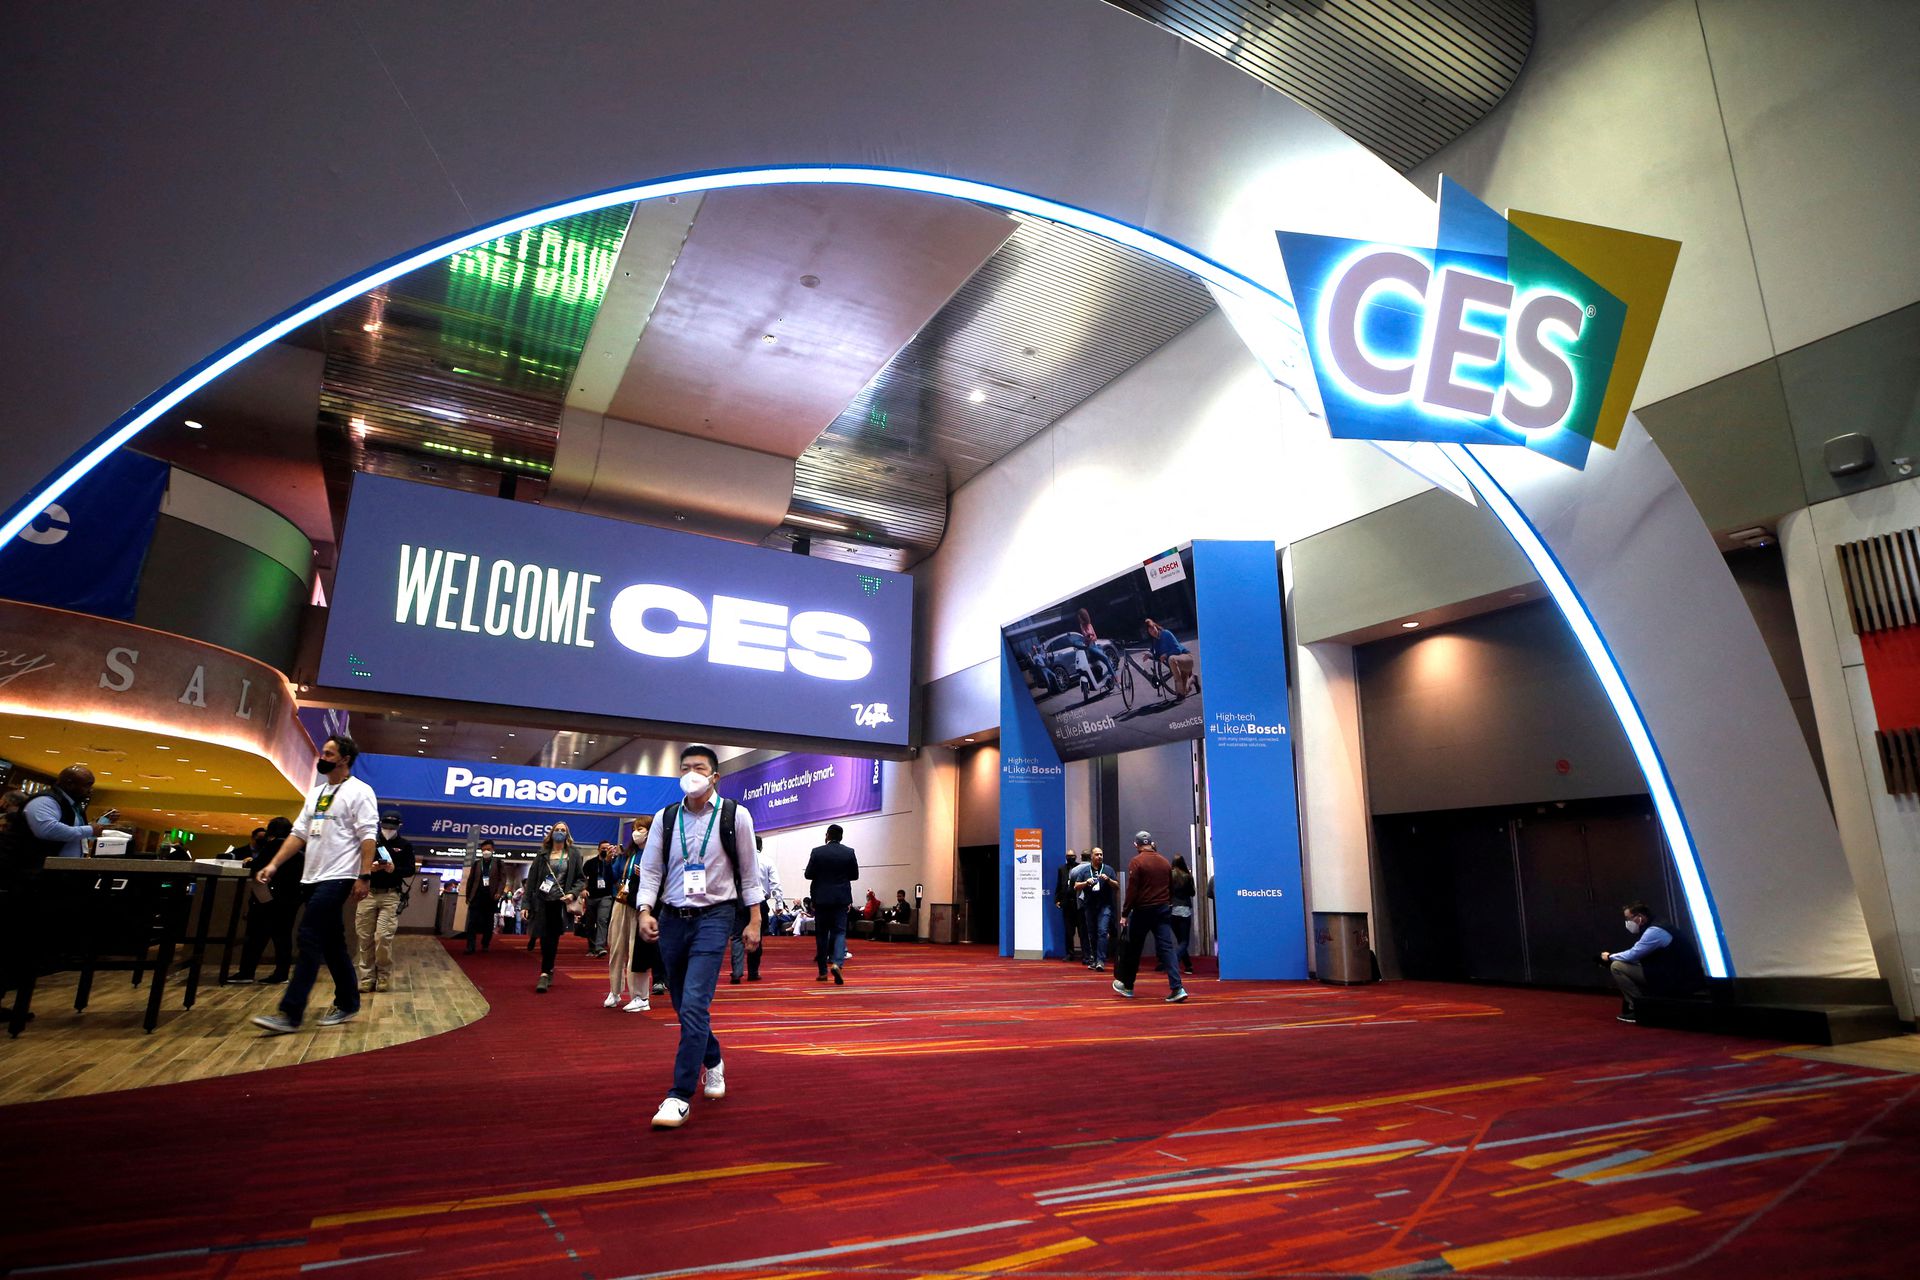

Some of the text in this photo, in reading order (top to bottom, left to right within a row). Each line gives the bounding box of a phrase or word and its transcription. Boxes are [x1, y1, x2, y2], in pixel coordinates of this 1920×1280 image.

[1158, 560, 1179, 575] BOSCH
[395, 543, 873, 682] WELCOME CES
[1055, 707, 1087, 723] High-tech
[1215, 712, 1256, 722] High-tech
[1055, 714, 1116, 740] #LikeABosch
[1168, 716, 1203, 730] #BoschCES
[1210, 723, 1286, 735] #LikeABosch
[1007, 757, 1039, 765] High-tech
[1003, 766, 1062, 774] #LikeABosch
[445, 767, 628, 806] Panasonic
[742, 764, 835, 801] A smart TV that's actually smart.
[1237, 889, 1283, 897] #BoschCES
